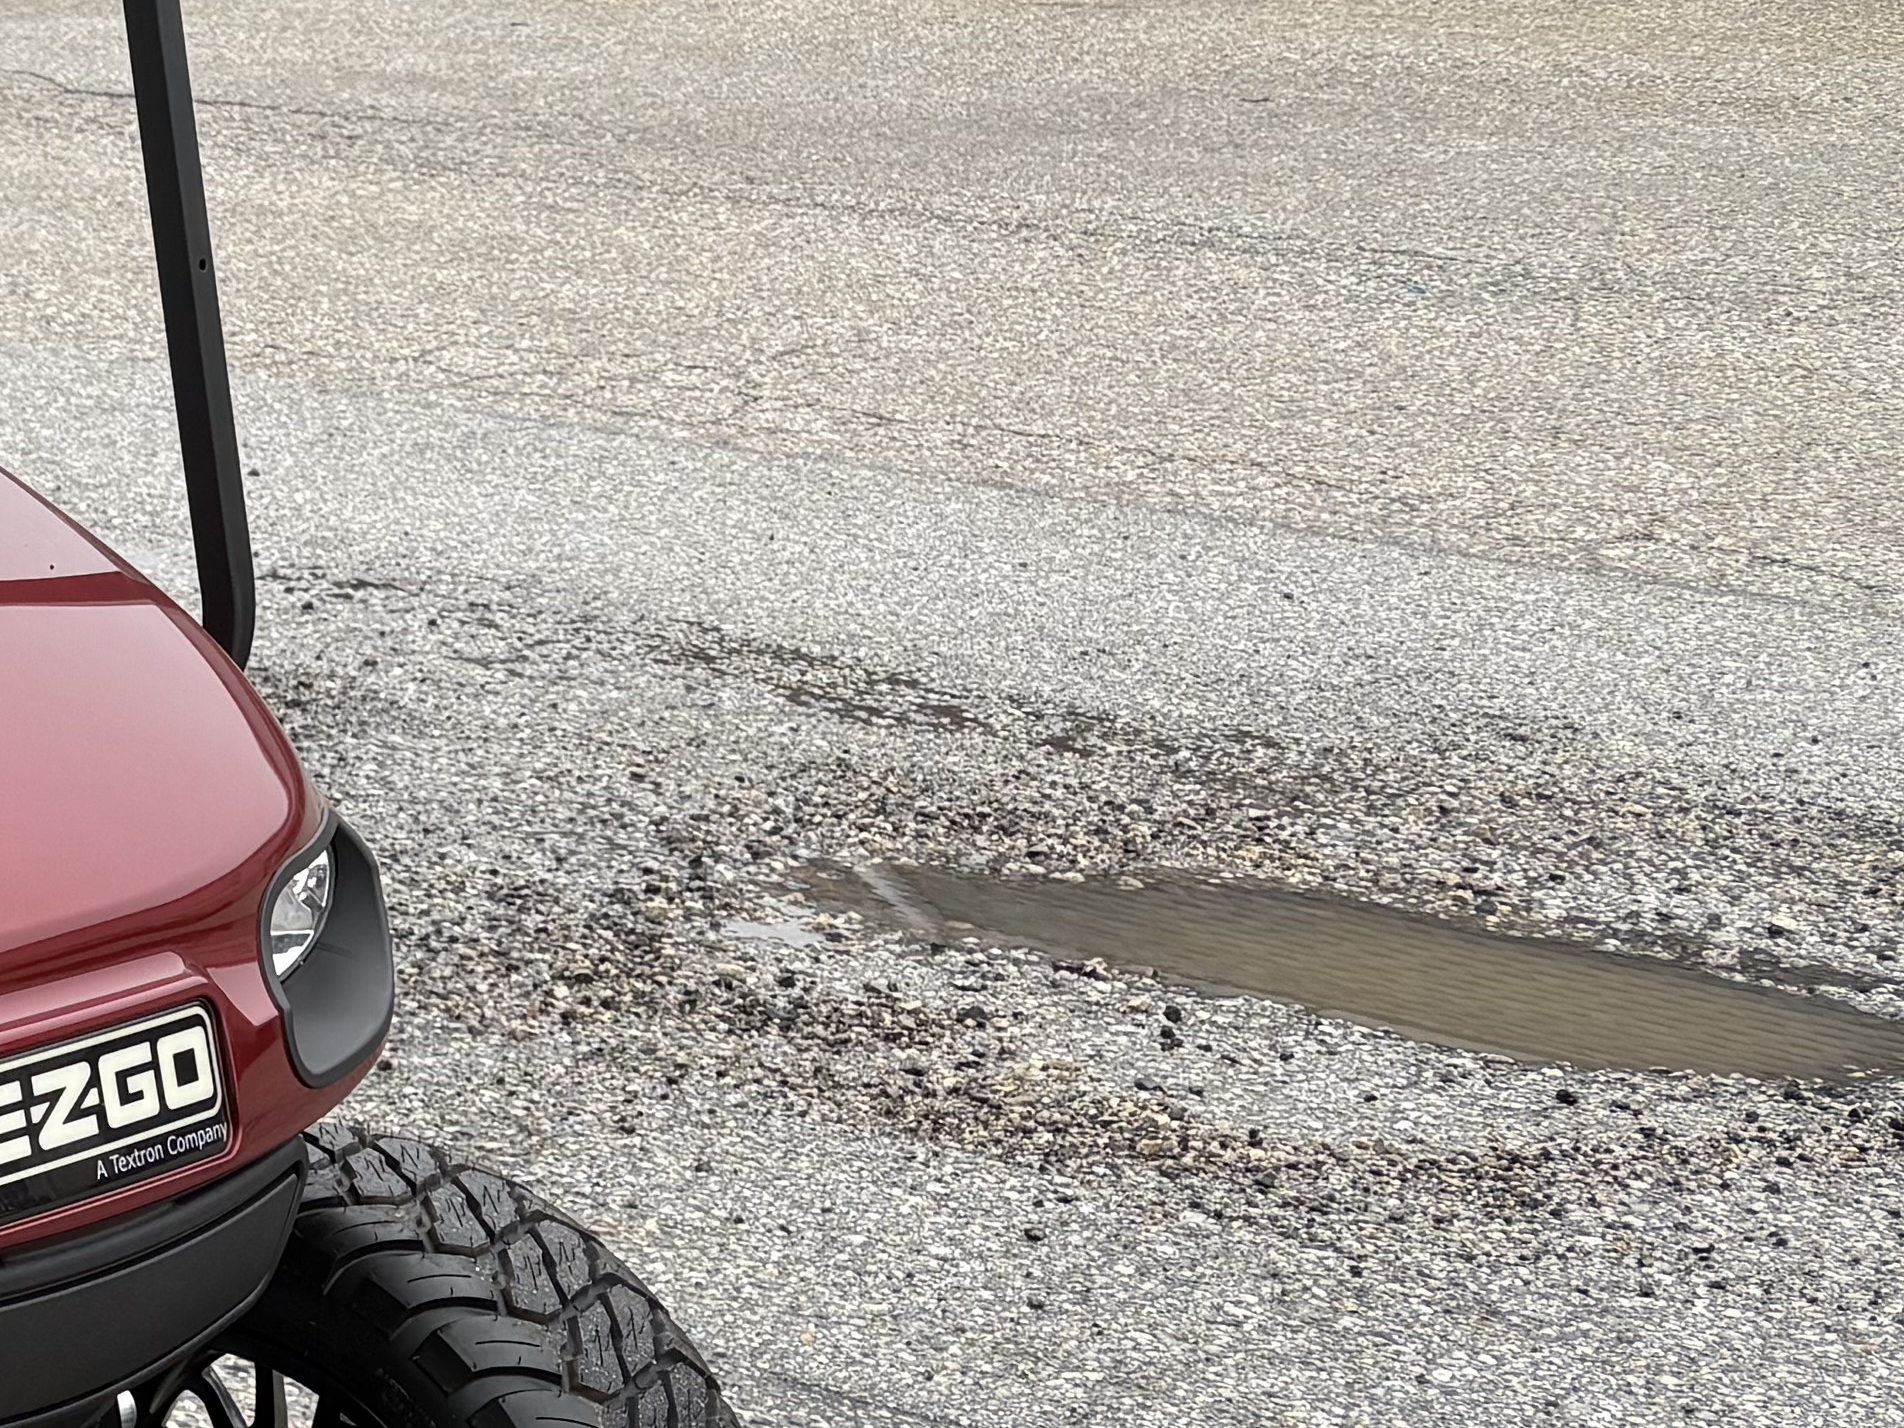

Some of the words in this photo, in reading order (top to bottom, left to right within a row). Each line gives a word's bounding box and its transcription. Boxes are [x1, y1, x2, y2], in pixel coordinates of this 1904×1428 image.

[96, 1158, 108, 1181] A
[109, 1145, 165, 1174] Textron
[167, 1120, 229, 1159] Company
